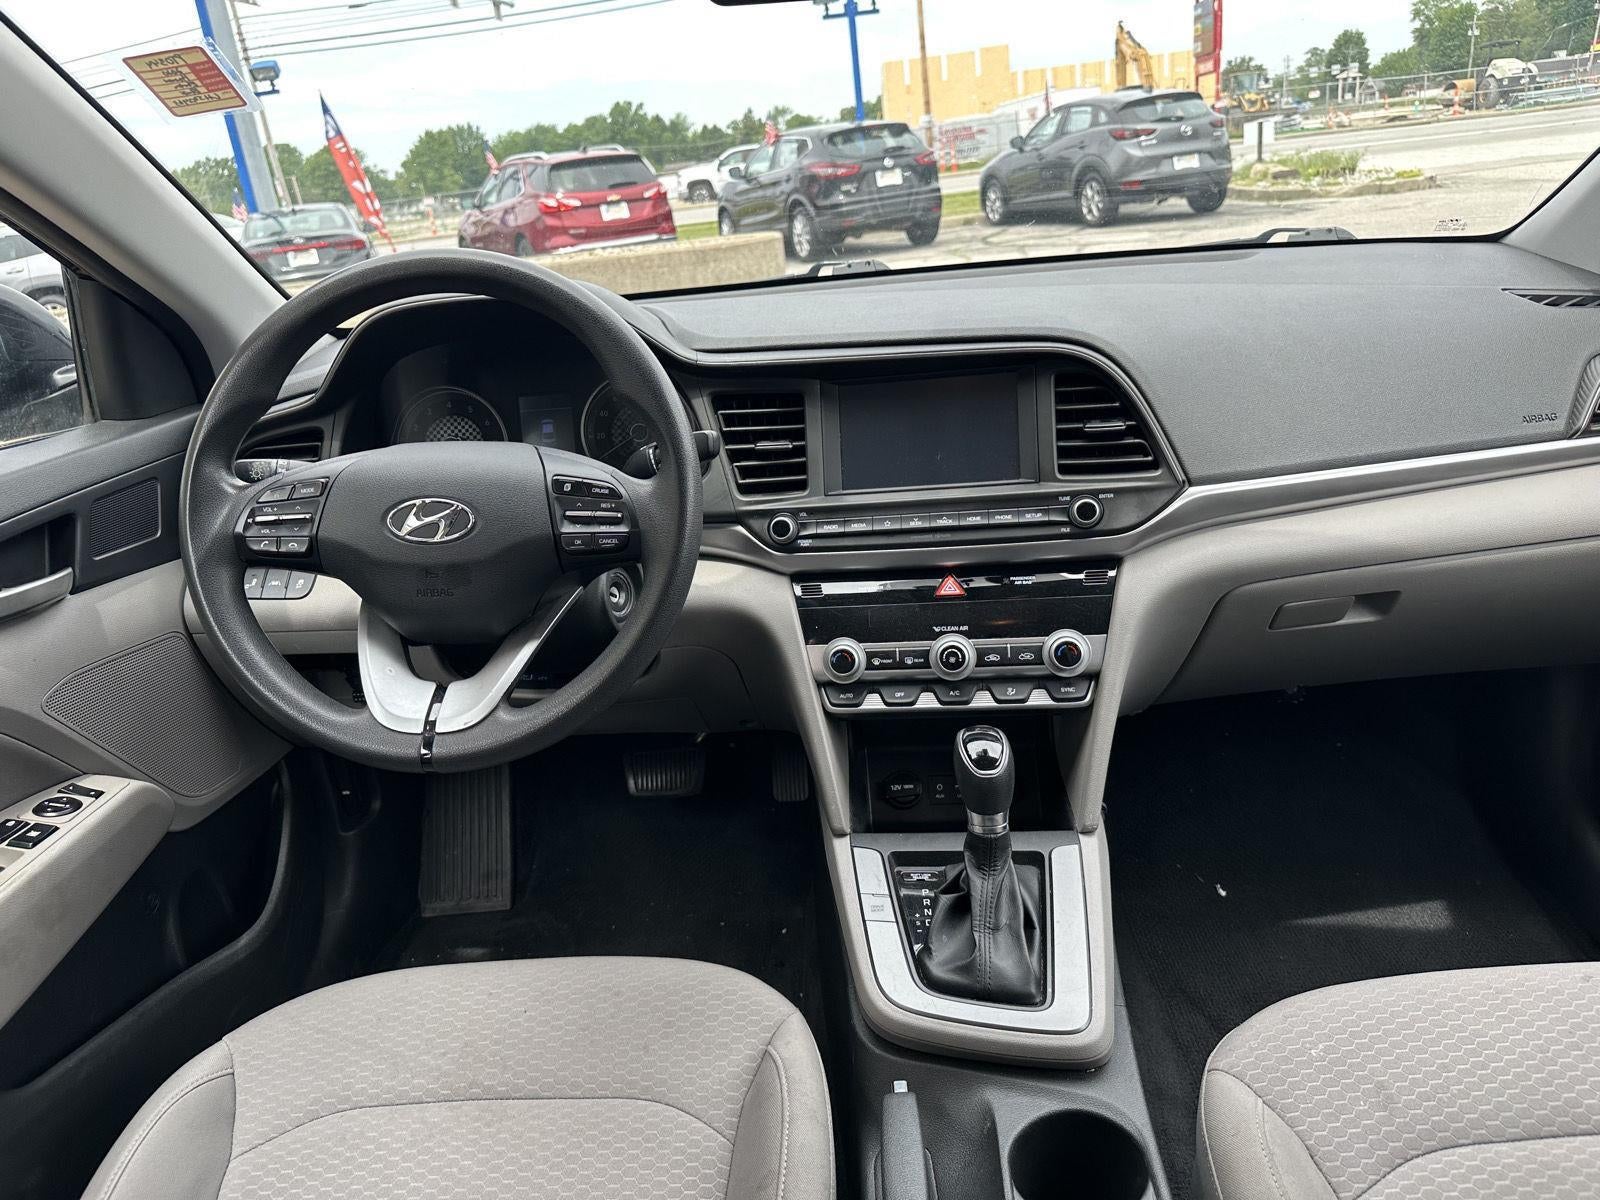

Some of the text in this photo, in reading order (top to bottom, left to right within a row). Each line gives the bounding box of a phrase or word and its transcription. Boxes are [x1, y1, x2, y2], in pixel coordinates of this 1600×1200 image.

[1522, 412, 1558, 424] AIRBAG
[416, 588, 455, 598] AIRBAG
[921, 888, 930, 896] P
[922, 898, 931, 906] R
[924, 908, 933, 916] N
